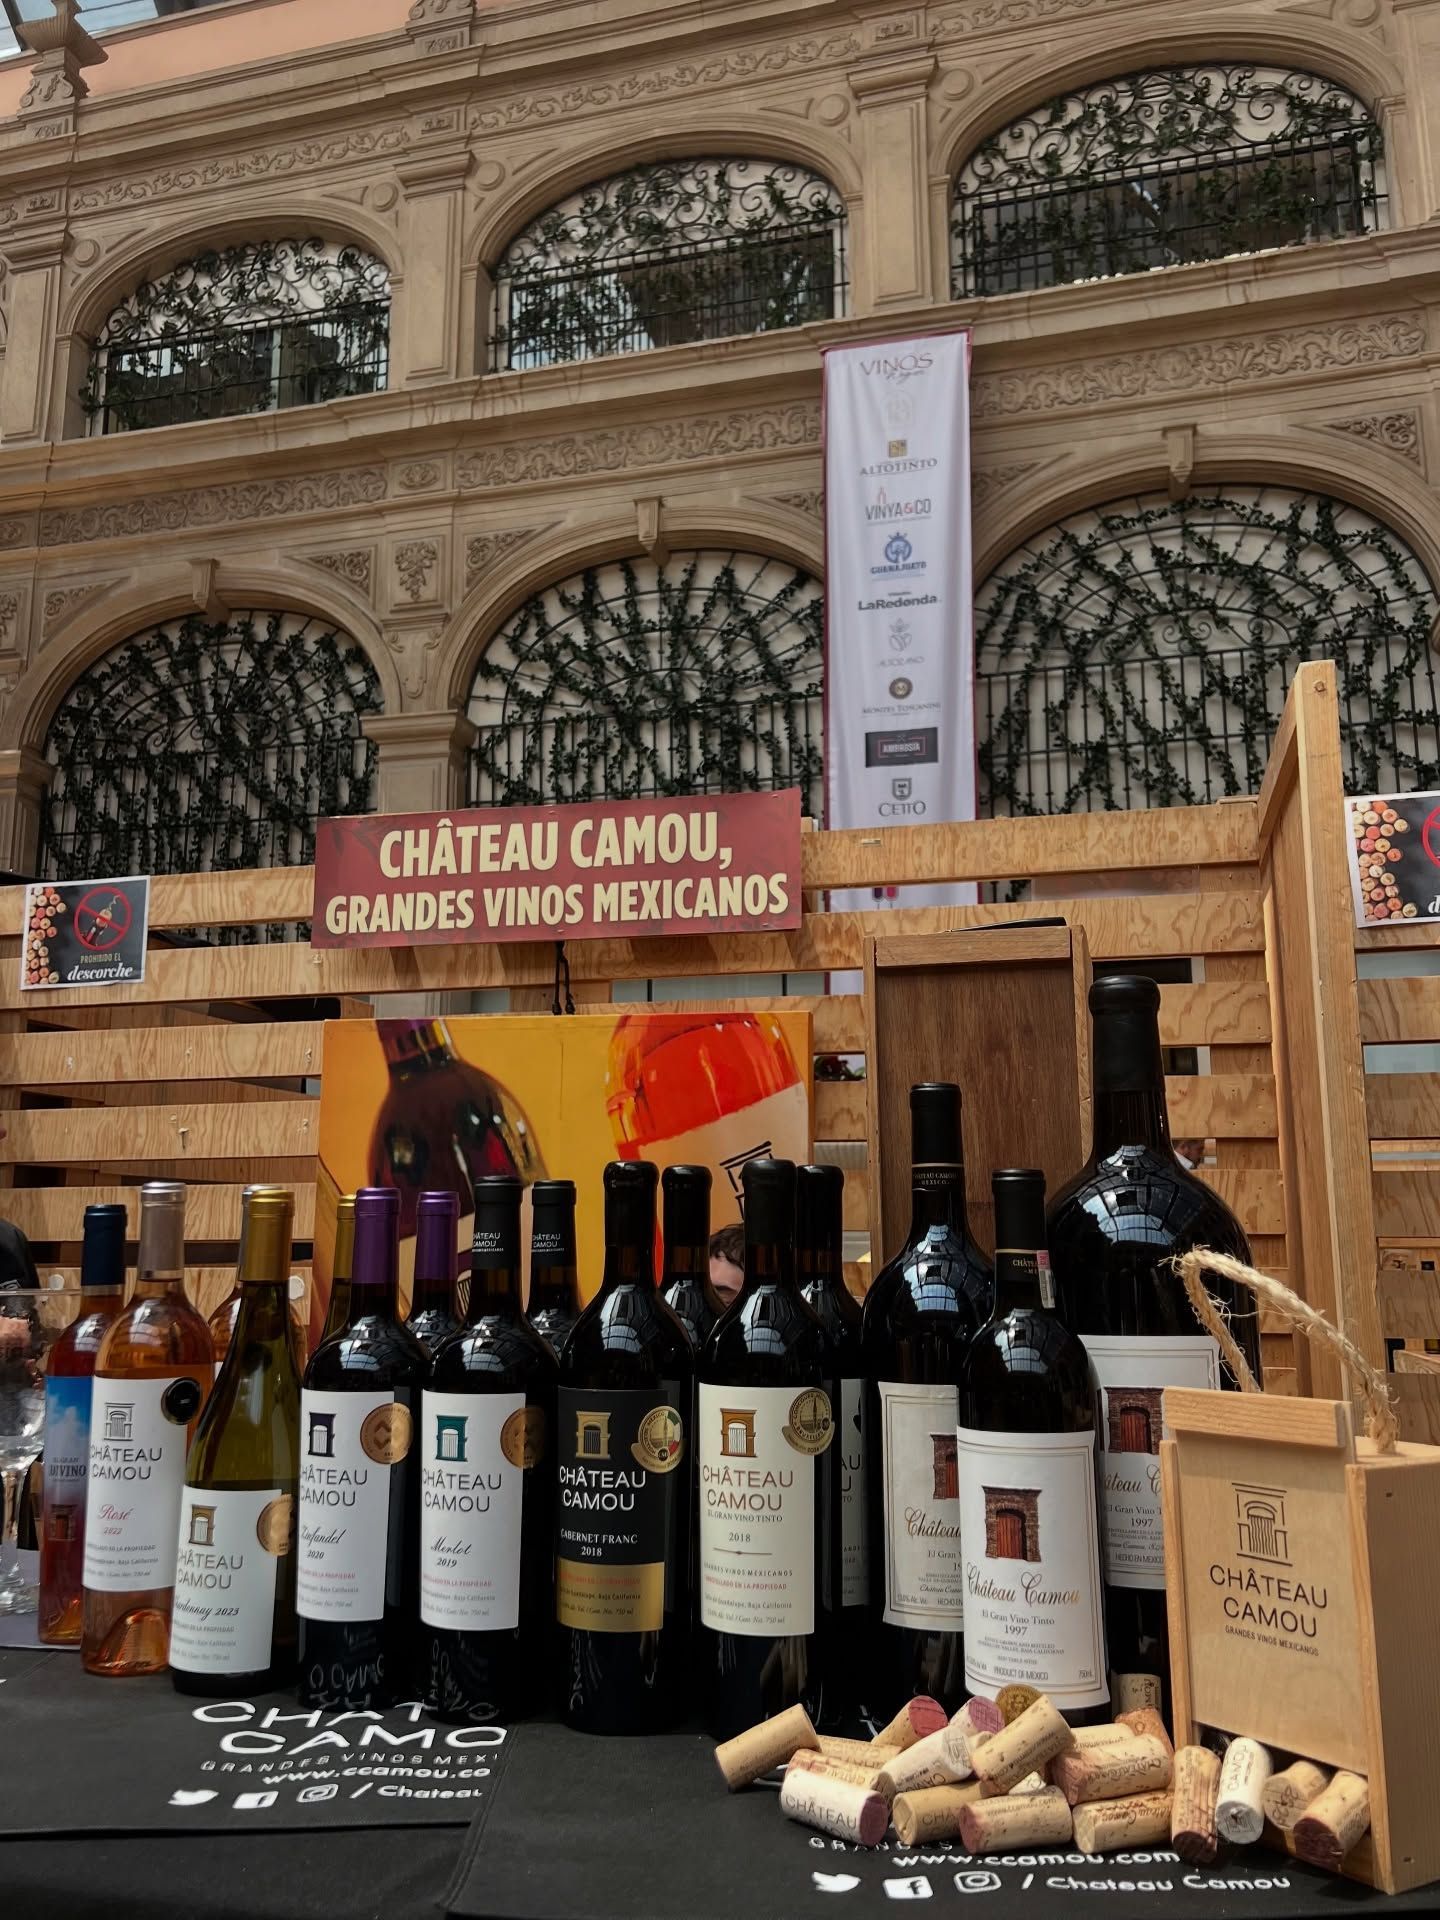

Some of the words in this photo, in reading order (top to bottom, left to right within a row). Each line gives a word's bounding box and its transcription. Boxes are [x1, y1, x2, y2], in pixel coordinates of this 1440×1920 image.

[860, 352, 933, 376] VINOS
[860, 458, 937, 475] ALTOTINTO
[865, 498, 931, 520] VINYA&CO
[858, 595, 938, 611] LaRedonda
[878, 801, 926, 817] CETTO
[379, 818, 559, 879] CHÂTEAU
[570, 811, 733, 870] CAMOU,
[325, 889, 475, 935] GRANDES
[483, 884, 584, 928] VINOS
[593, 873, 788, 923] MEXICANOS
[81, 953, 112, 964] PROHIBIDO
[67, 962, 133, 981] descorche
[91, 1445, 162, 1461] CHÂTEAU
[92, 1464, 151, 1480] CAMOU
[301, 1464, 367, 1485] HÂTEAU
[423, 1468, 502, 1490] CHÂTEAU
[560, 1465, 646, 1488] CHÂTEAU
[703, 1465, 793, 1488] CHÂTEAU
[1104, 1472, 1142, 1493] âteau
[424, 1491, 490, 1512] CAMOU
[563, 1489, 635, 1511] CAMOU
[707, 1489, 782, 1511] CAMOU
[99, 1503, 135, 1520] Rosé
[714, 1511, 733, 1520] GRAN
[735, 1513, 754, 1522] VINO
[756, 1515, 783, 1523] TINTO
[1115, 1505, 1134, 1514] Gran
[1136, 1506, 1155, 1515] Vino
[1131, 1517, 1153, 1528] 1997
[560, 1528, 599, 1544] CABERNET
[602, 1534, 638, 1545] FRANC
[729, 1532, 751, 1542] 2018
[430, 1536, 472, 1555] Merlot
[581, 1546, 602, 1557] 2018
[307, 1550, 325, 1560] 2020
[437, 1557, 458, 1568] 2019
[938, 1551, 956, 1559] Gran
[178, 1570, 232, 1589] CAMOU
[752, 1583, 787, 1591] PROPIEDAD
[967, 1562, 1016, 1602] Château
[1021, 1571, 1080, 1607] Camou
[1210, 1564, 1327, 1609] CHÂTEAU
[215, 1607, 240, 1617] 2023
[982, 1610, 989, 1618] El
[990, 1612, 1008, 1621] Gran
[1010, 1614, 1030, 1624] Vino
[1031, 1616, 1055, 1625] Tinto
[1223, 1597, 1317, 1638] CAMOU
[1004, 1624, 1028, 1636] 1997
[1225, 1624, 1256, 1640] GRANDES
[1257, 1633, 1277, 1646] VINOS
[1279, 1638, 1319, 1656] MEXICANOS
[994, 1666, 1018, 1678] PRODUCT
[1026, 1670, 1049, 1680] MEXICO
[219, 1725, 507, 1755] CAMO
[201, 1755, 329, 1773] GRANDES
[341, 1752, 423, 1764] VINOS
[262, 1767, 490, 1785] www.ccamou.co
[785, 1795, 857, 1829] CHÂTEAU
[892, 1851, 1180, 1866] www.ccamou.com
[1046, 1875, 1174, 1891] Chateau
[1182, 1874, 1291, 1890] Camou
